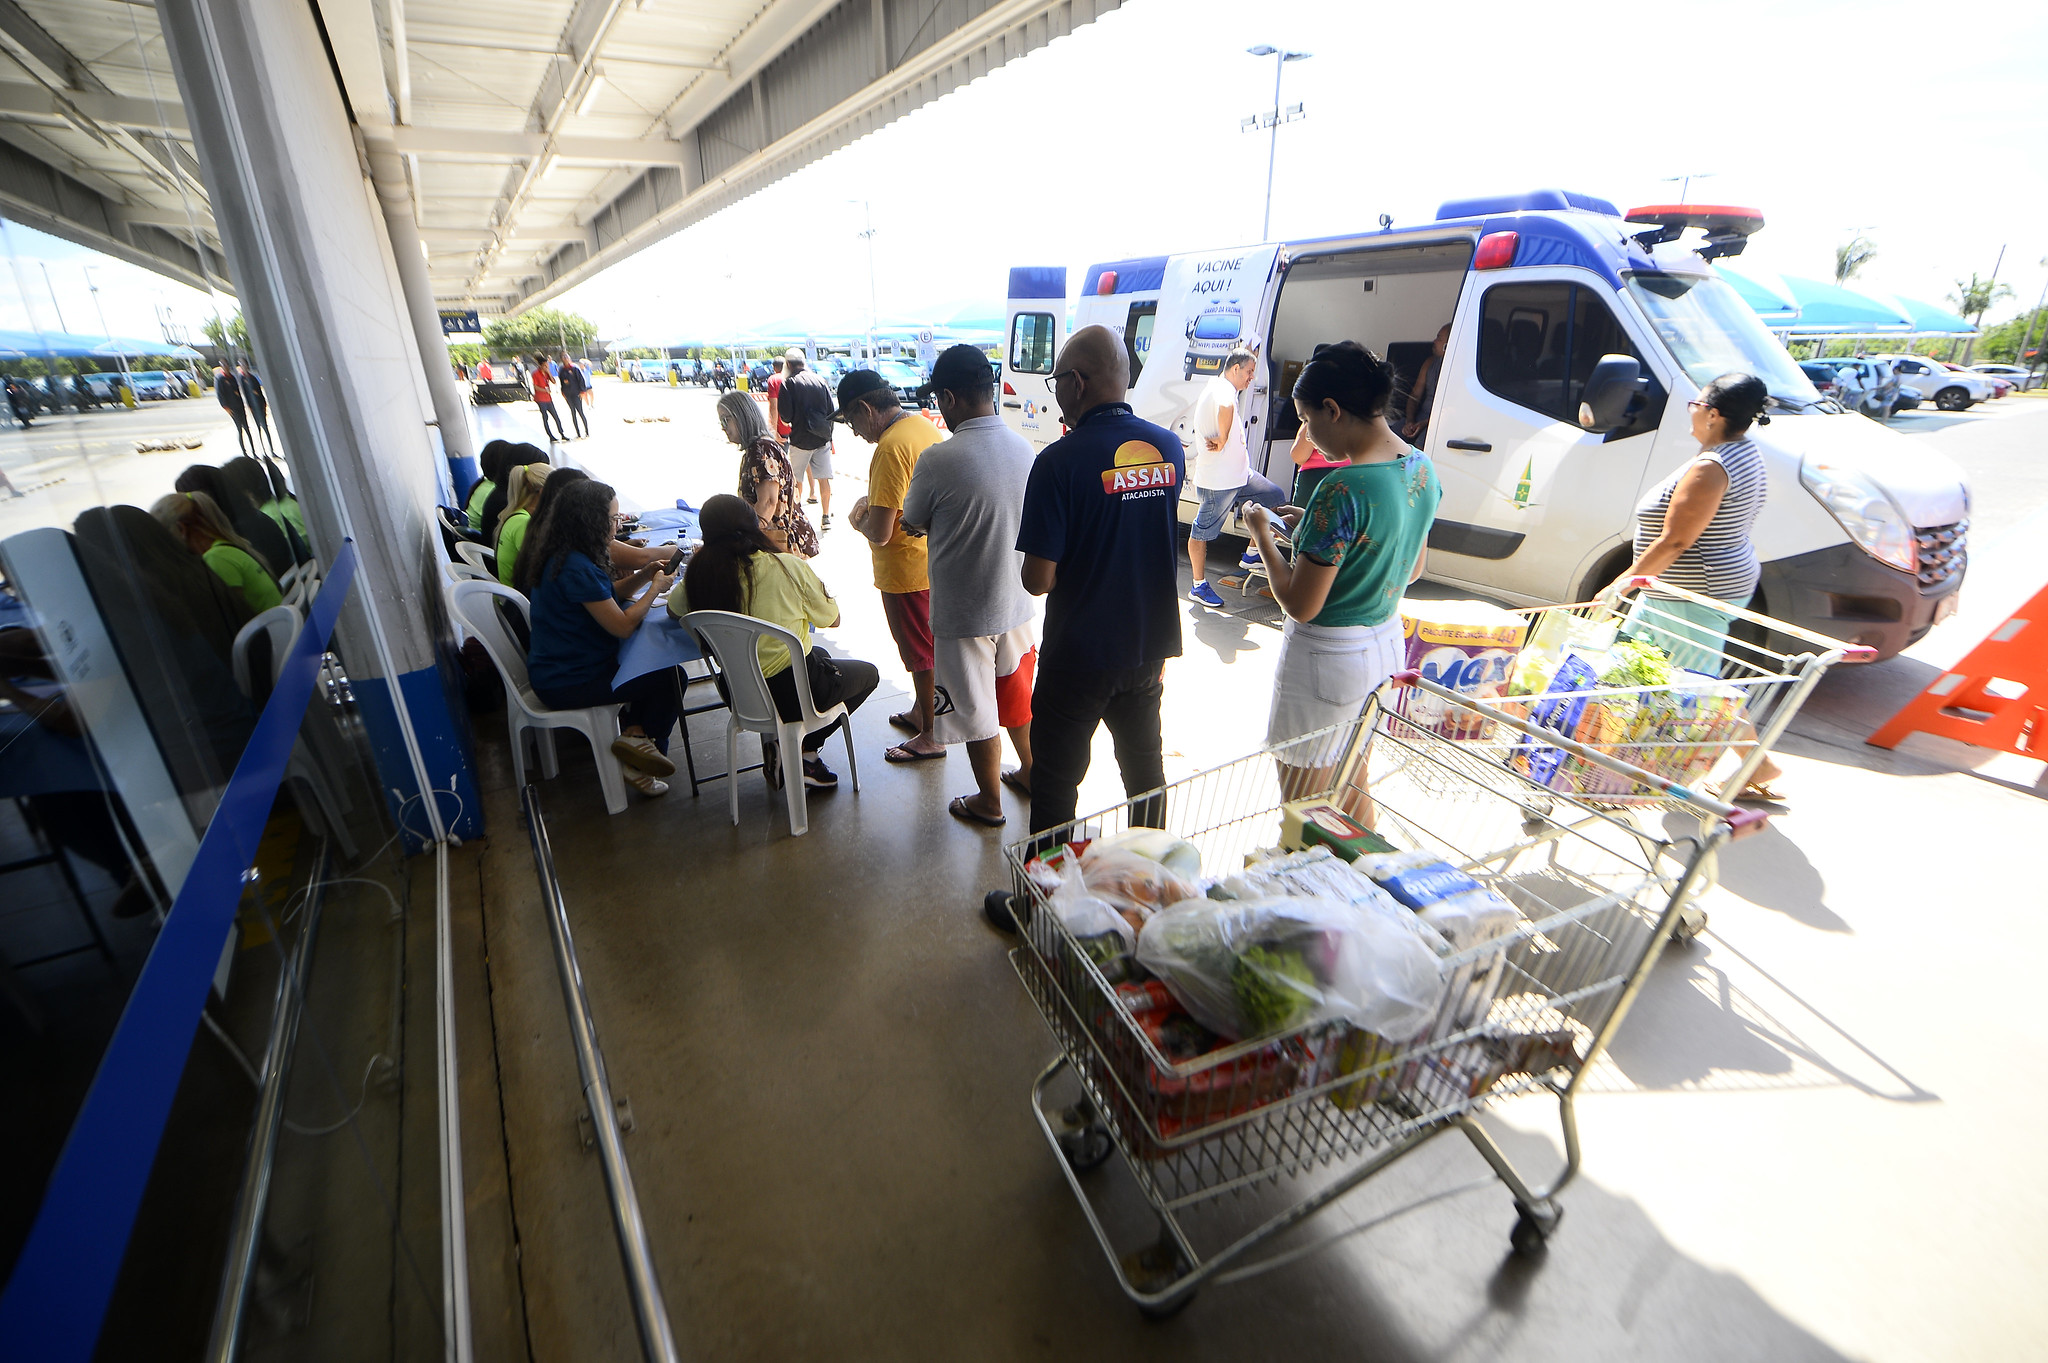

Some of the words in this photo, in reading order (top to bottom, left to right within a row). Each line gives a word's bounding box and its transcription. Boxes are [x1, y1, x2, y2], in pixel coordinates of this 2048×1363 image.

[1197, 257, 1244, 273] VACINE
[1192, 279, 1225, 294] AQUI
[1135, 336, 1151, 352] SU
[1113, 464, 1170, 490] ASSAÍ
[1121, 489, 1165, 501] ATACADISTA
